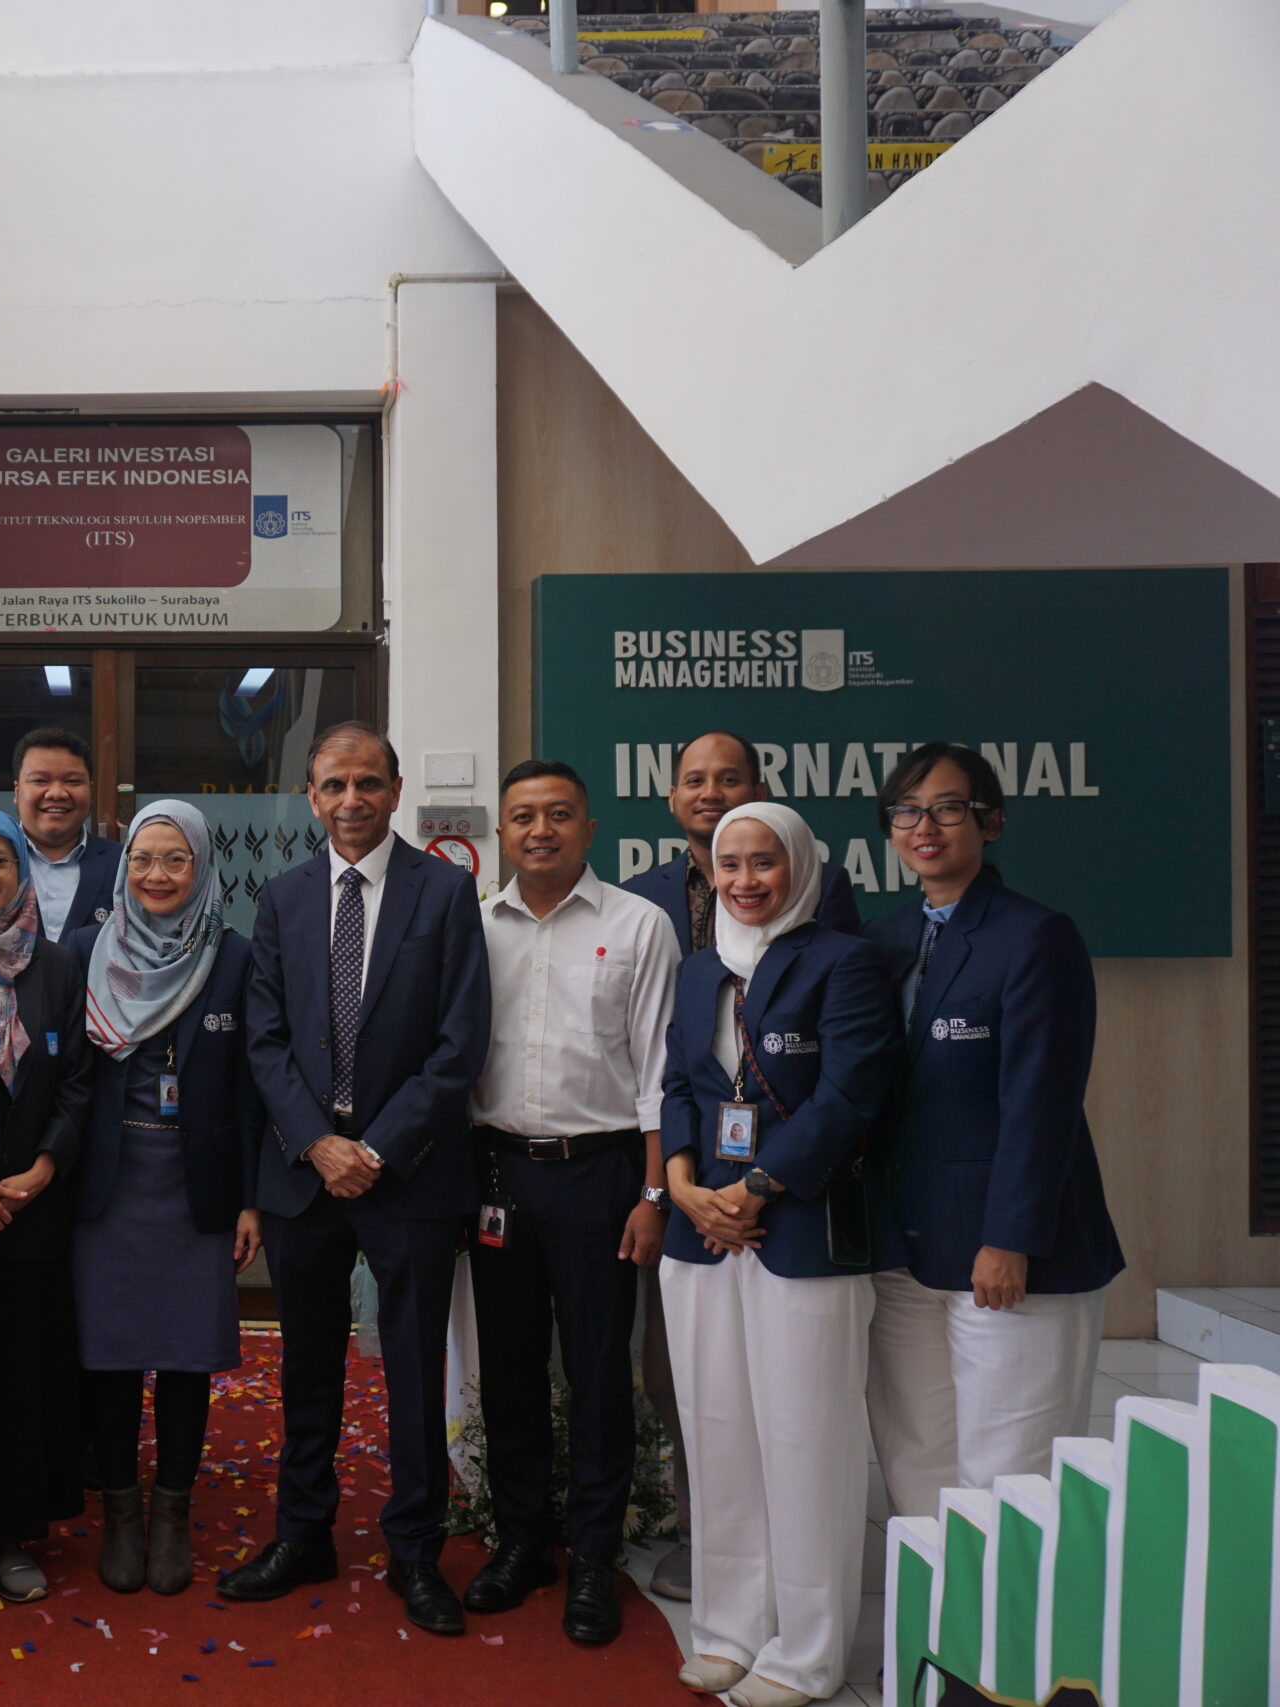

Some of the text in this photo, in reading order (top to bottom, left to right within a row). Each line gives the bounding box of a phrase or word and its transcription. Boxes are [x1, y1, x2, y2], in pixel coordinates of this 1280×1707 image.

[893, 152, 941, 169] HAND
[6, 446, 215, 463] GALERI INVESTASI
[57, 470, 118, 486] EFEK
[123, 469, 250, 485] INDONESIA
[35, 515, 110, 525] TEKNOLOGI
[113, 515, 172, 525] SEPULUH
[175, 514, 246, 525] NOPEMBER
[291, 511, 312, 521] ITS
[85, 531, 135, 549] (ITS)
[1, 595, 35, 606] Jalan
[38, 595, 69, 608] Raya
[73, 595, 92, 605] ITS
[95, 594, 146, 605] Sukolilo
[161, 594, 220, 608] Surabaya
[89, 612, 158, 626] UNTUK
[163, 611, 229, 626] UMUM
[614, 630, 798, 659] BUSINESS
[848, 650, 874, 665] ITS
[614, 660, 799, 688] MANAGEMENT
[615, 742, 1100, 797] INRNATNAL
[949, 1018, 967, 1028] ITS
[784, 1033, 801, 1042] ITS
